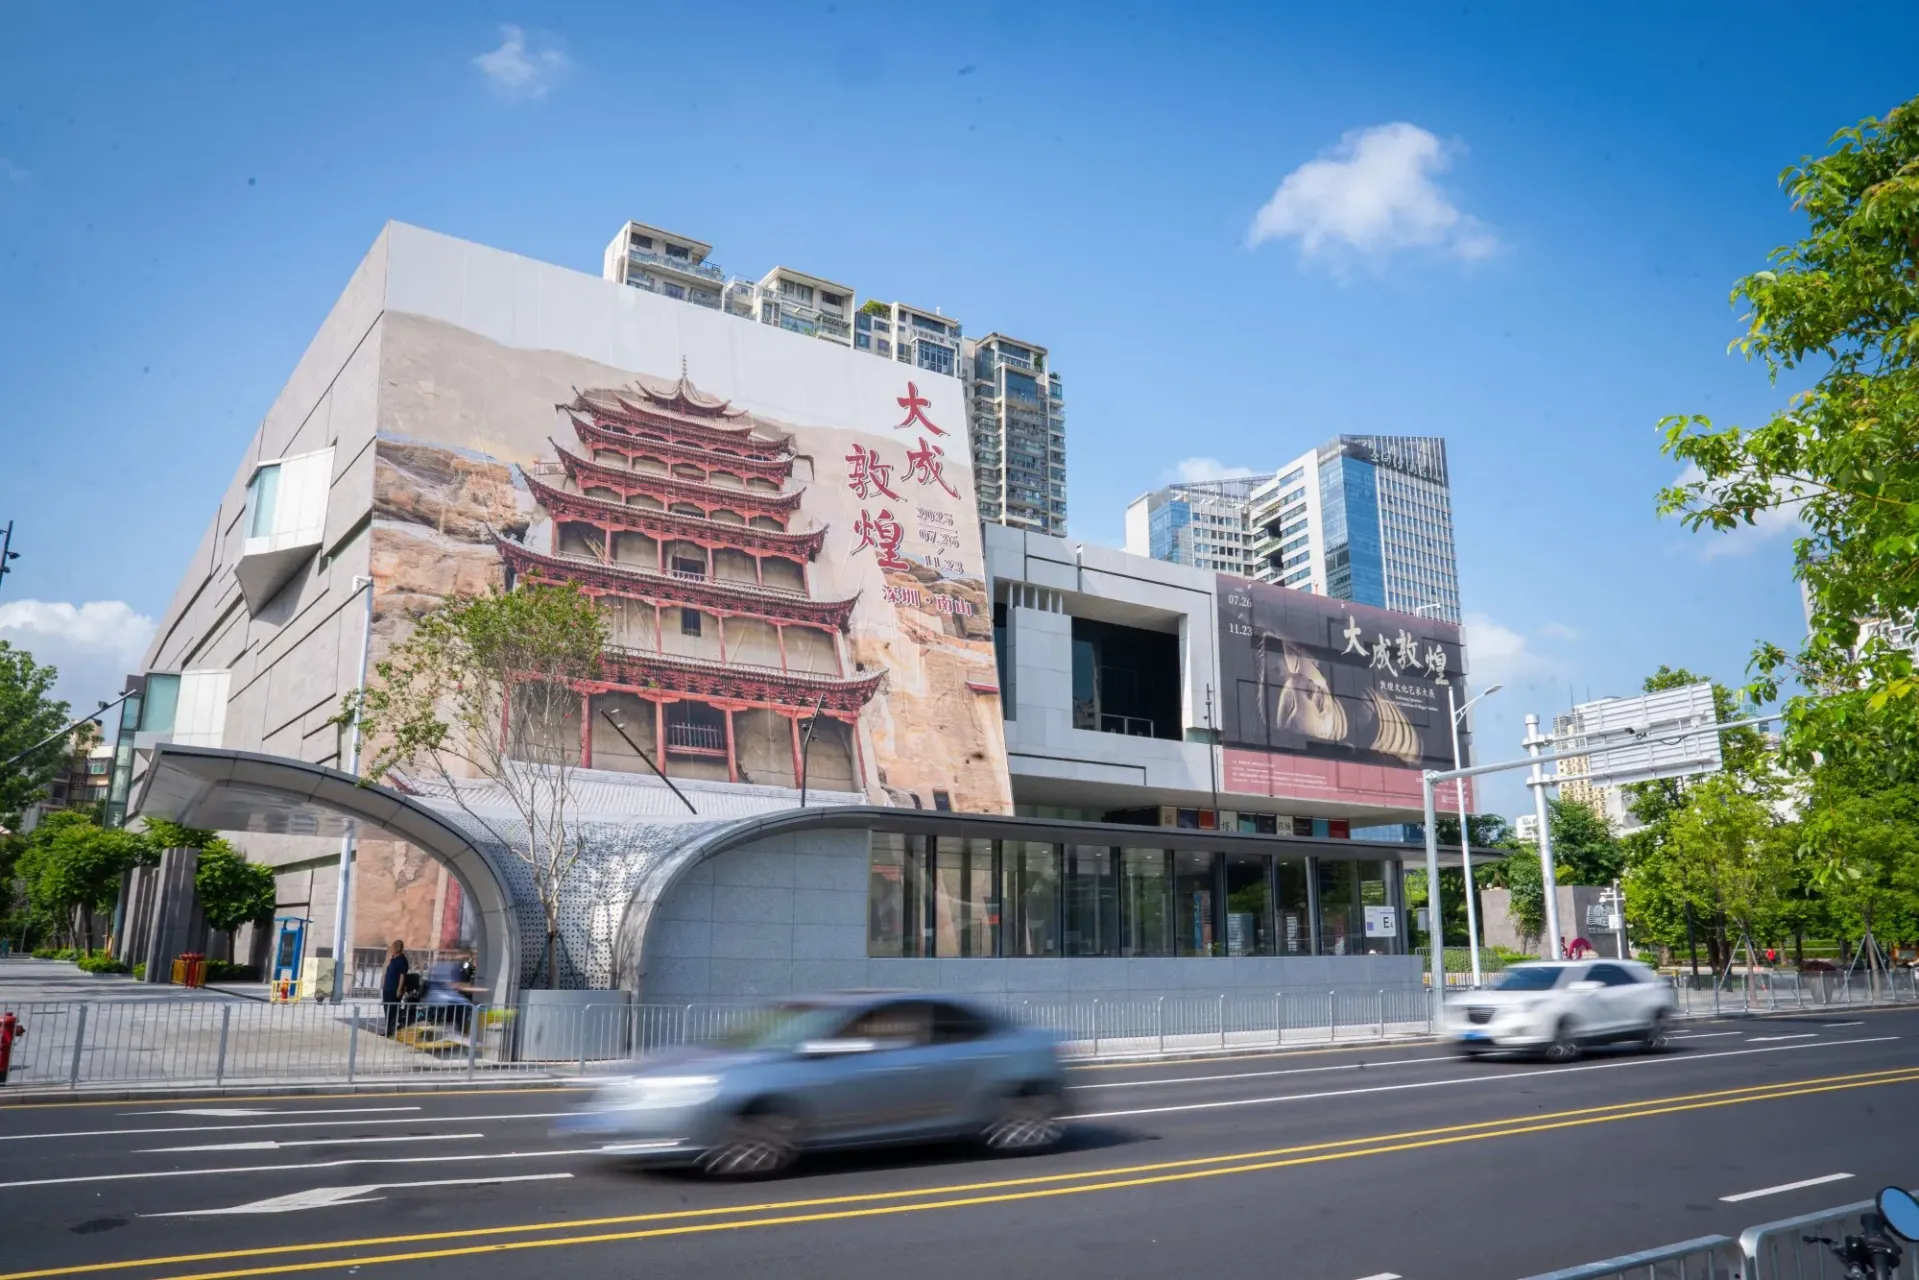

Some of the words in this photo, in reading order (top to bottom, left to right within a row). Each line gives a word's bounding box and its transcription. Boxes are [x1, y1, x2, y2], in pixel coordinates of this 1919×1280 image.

[893, 380, 961, 499] 大成
[845, 443, 908, 571] 敦煌
[916, 507, 954, 525] 2025
[925, 556, 964, 574] 11.23
[1228, 594, 1252, 608] 07.26
[1229, 622, 1253, 637] 11.23
[1340, 615, 1450, 685] 大成敦煌
